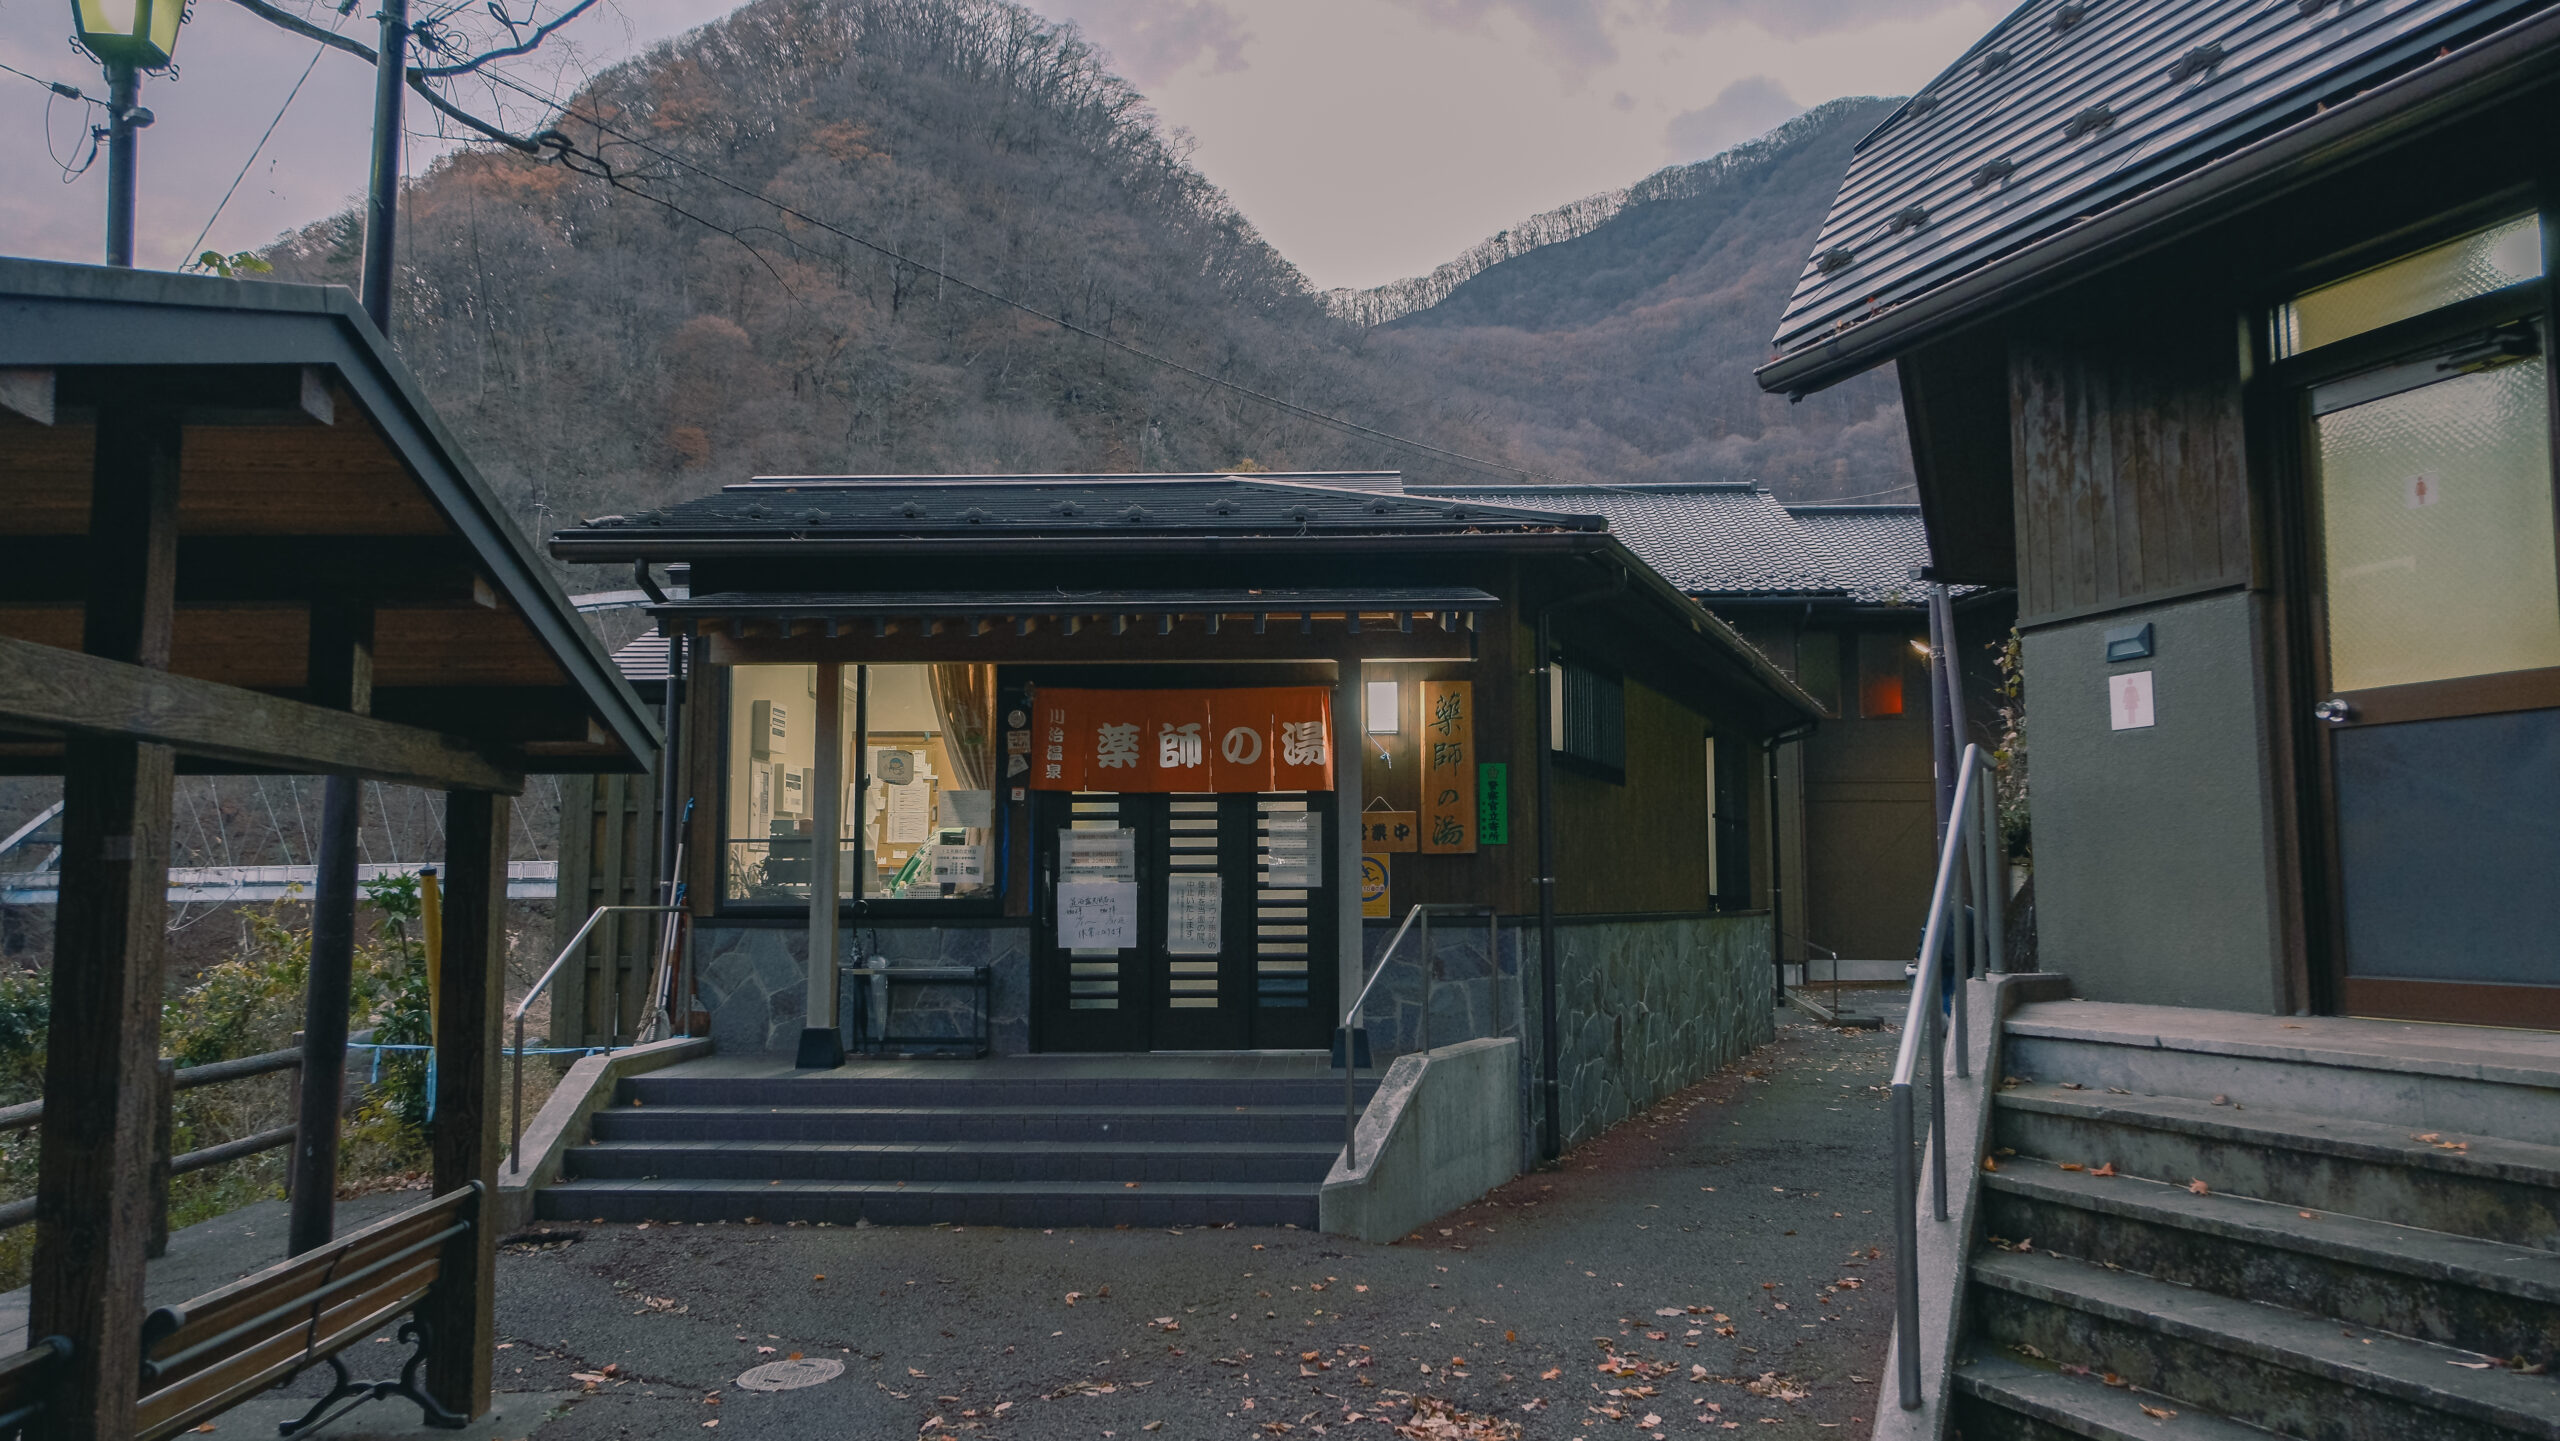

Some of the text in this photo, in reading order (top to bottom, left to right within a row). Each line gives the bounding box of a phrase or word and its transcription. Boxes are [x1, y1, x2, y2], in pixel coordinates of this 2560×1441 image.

[1045, 708, 1065, 780] 川治温泉
[1097, 721, 1326, 769] 薬師の湯
[1186, 881, 1195, 940] 中止いたします。
